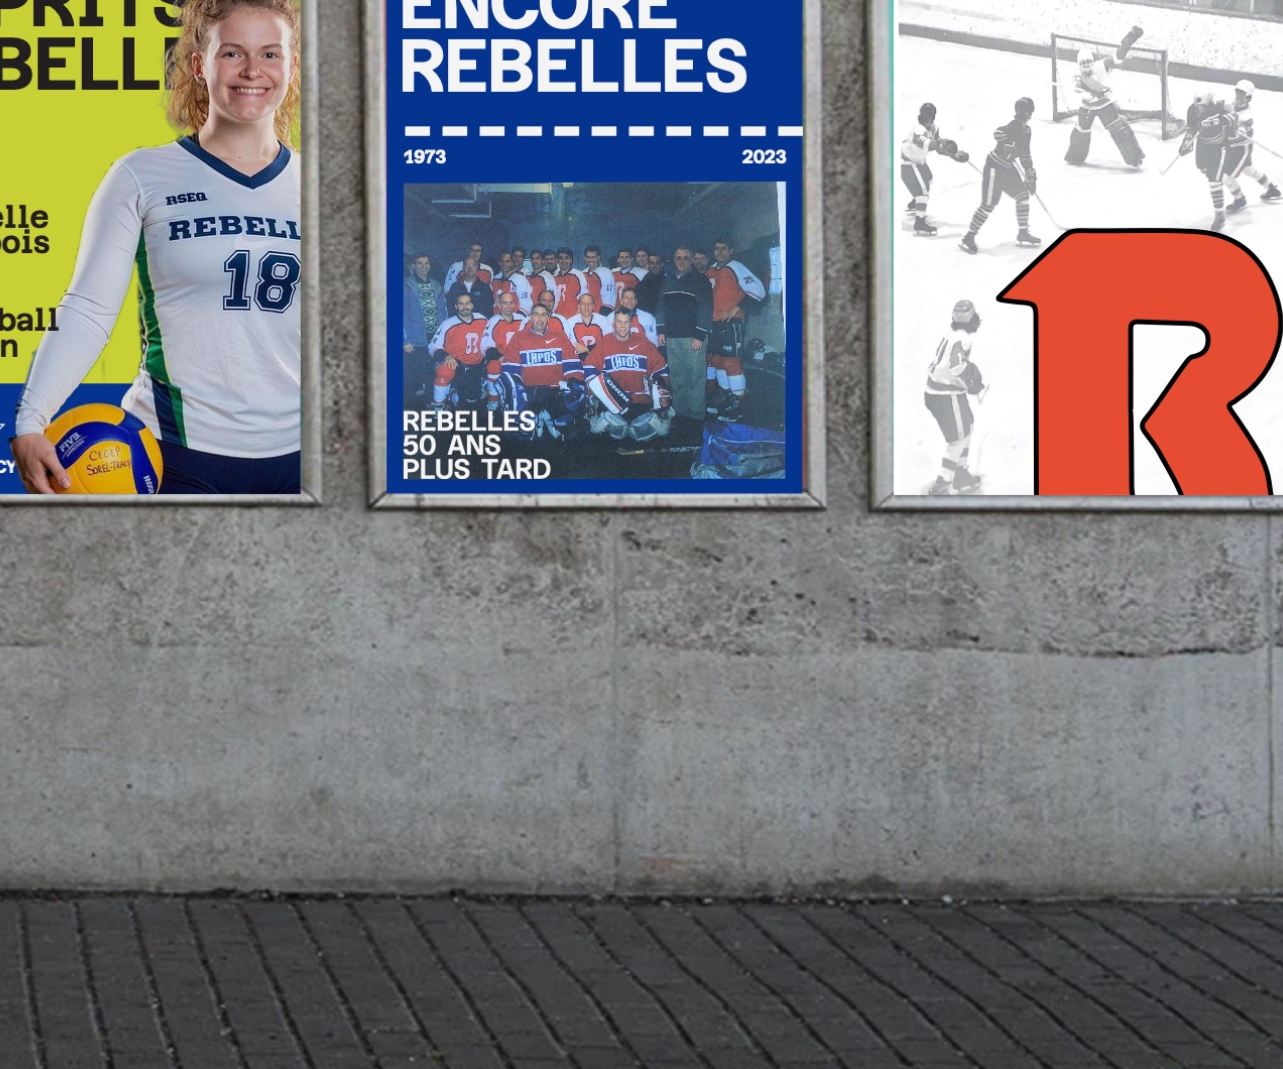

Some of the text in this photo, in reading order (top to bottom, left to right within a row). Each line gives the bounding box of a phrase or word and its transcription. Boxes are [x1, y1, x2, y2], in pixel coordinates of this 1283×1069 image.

[403, 38, 747, 93] REBELLES
[404, 149, 446, 163] 1973
[742, 150, 786, 163] 2023
[223, 250, 301, 314] 18
[402, 410, 536, 431] REBELLES
[404, 435, 500, 455] 50 ANS
[404, 459, 550, 479] PLUS TARD
